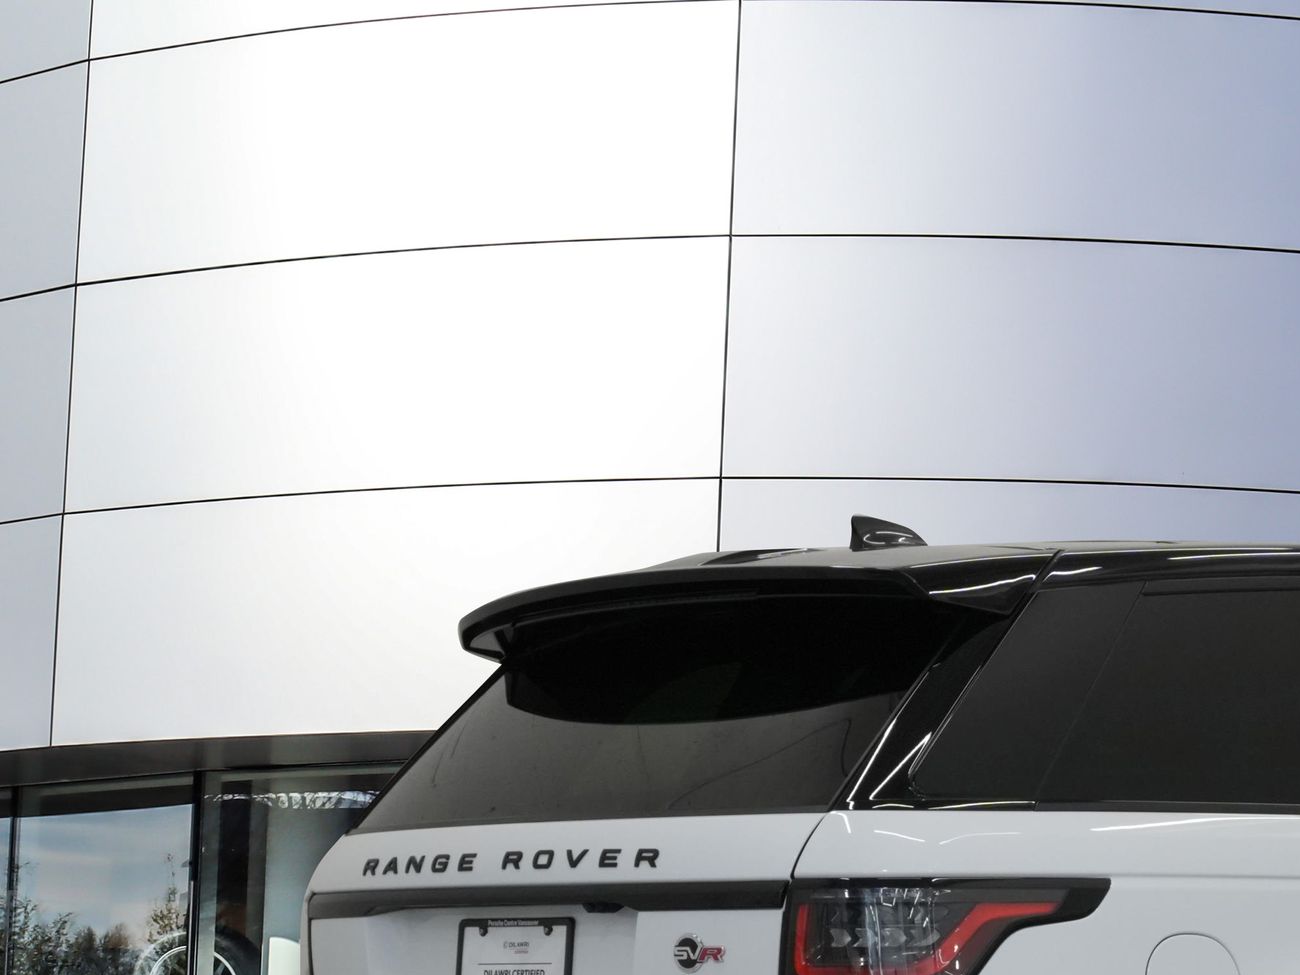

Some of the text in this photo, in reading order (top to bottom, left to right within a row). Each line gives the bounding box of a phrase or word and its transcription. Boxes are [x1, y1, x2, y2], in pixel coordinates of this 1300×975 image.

[362, 848, 660, 877] RANGE ROVER
[673, 945, 725, 963] SVR
